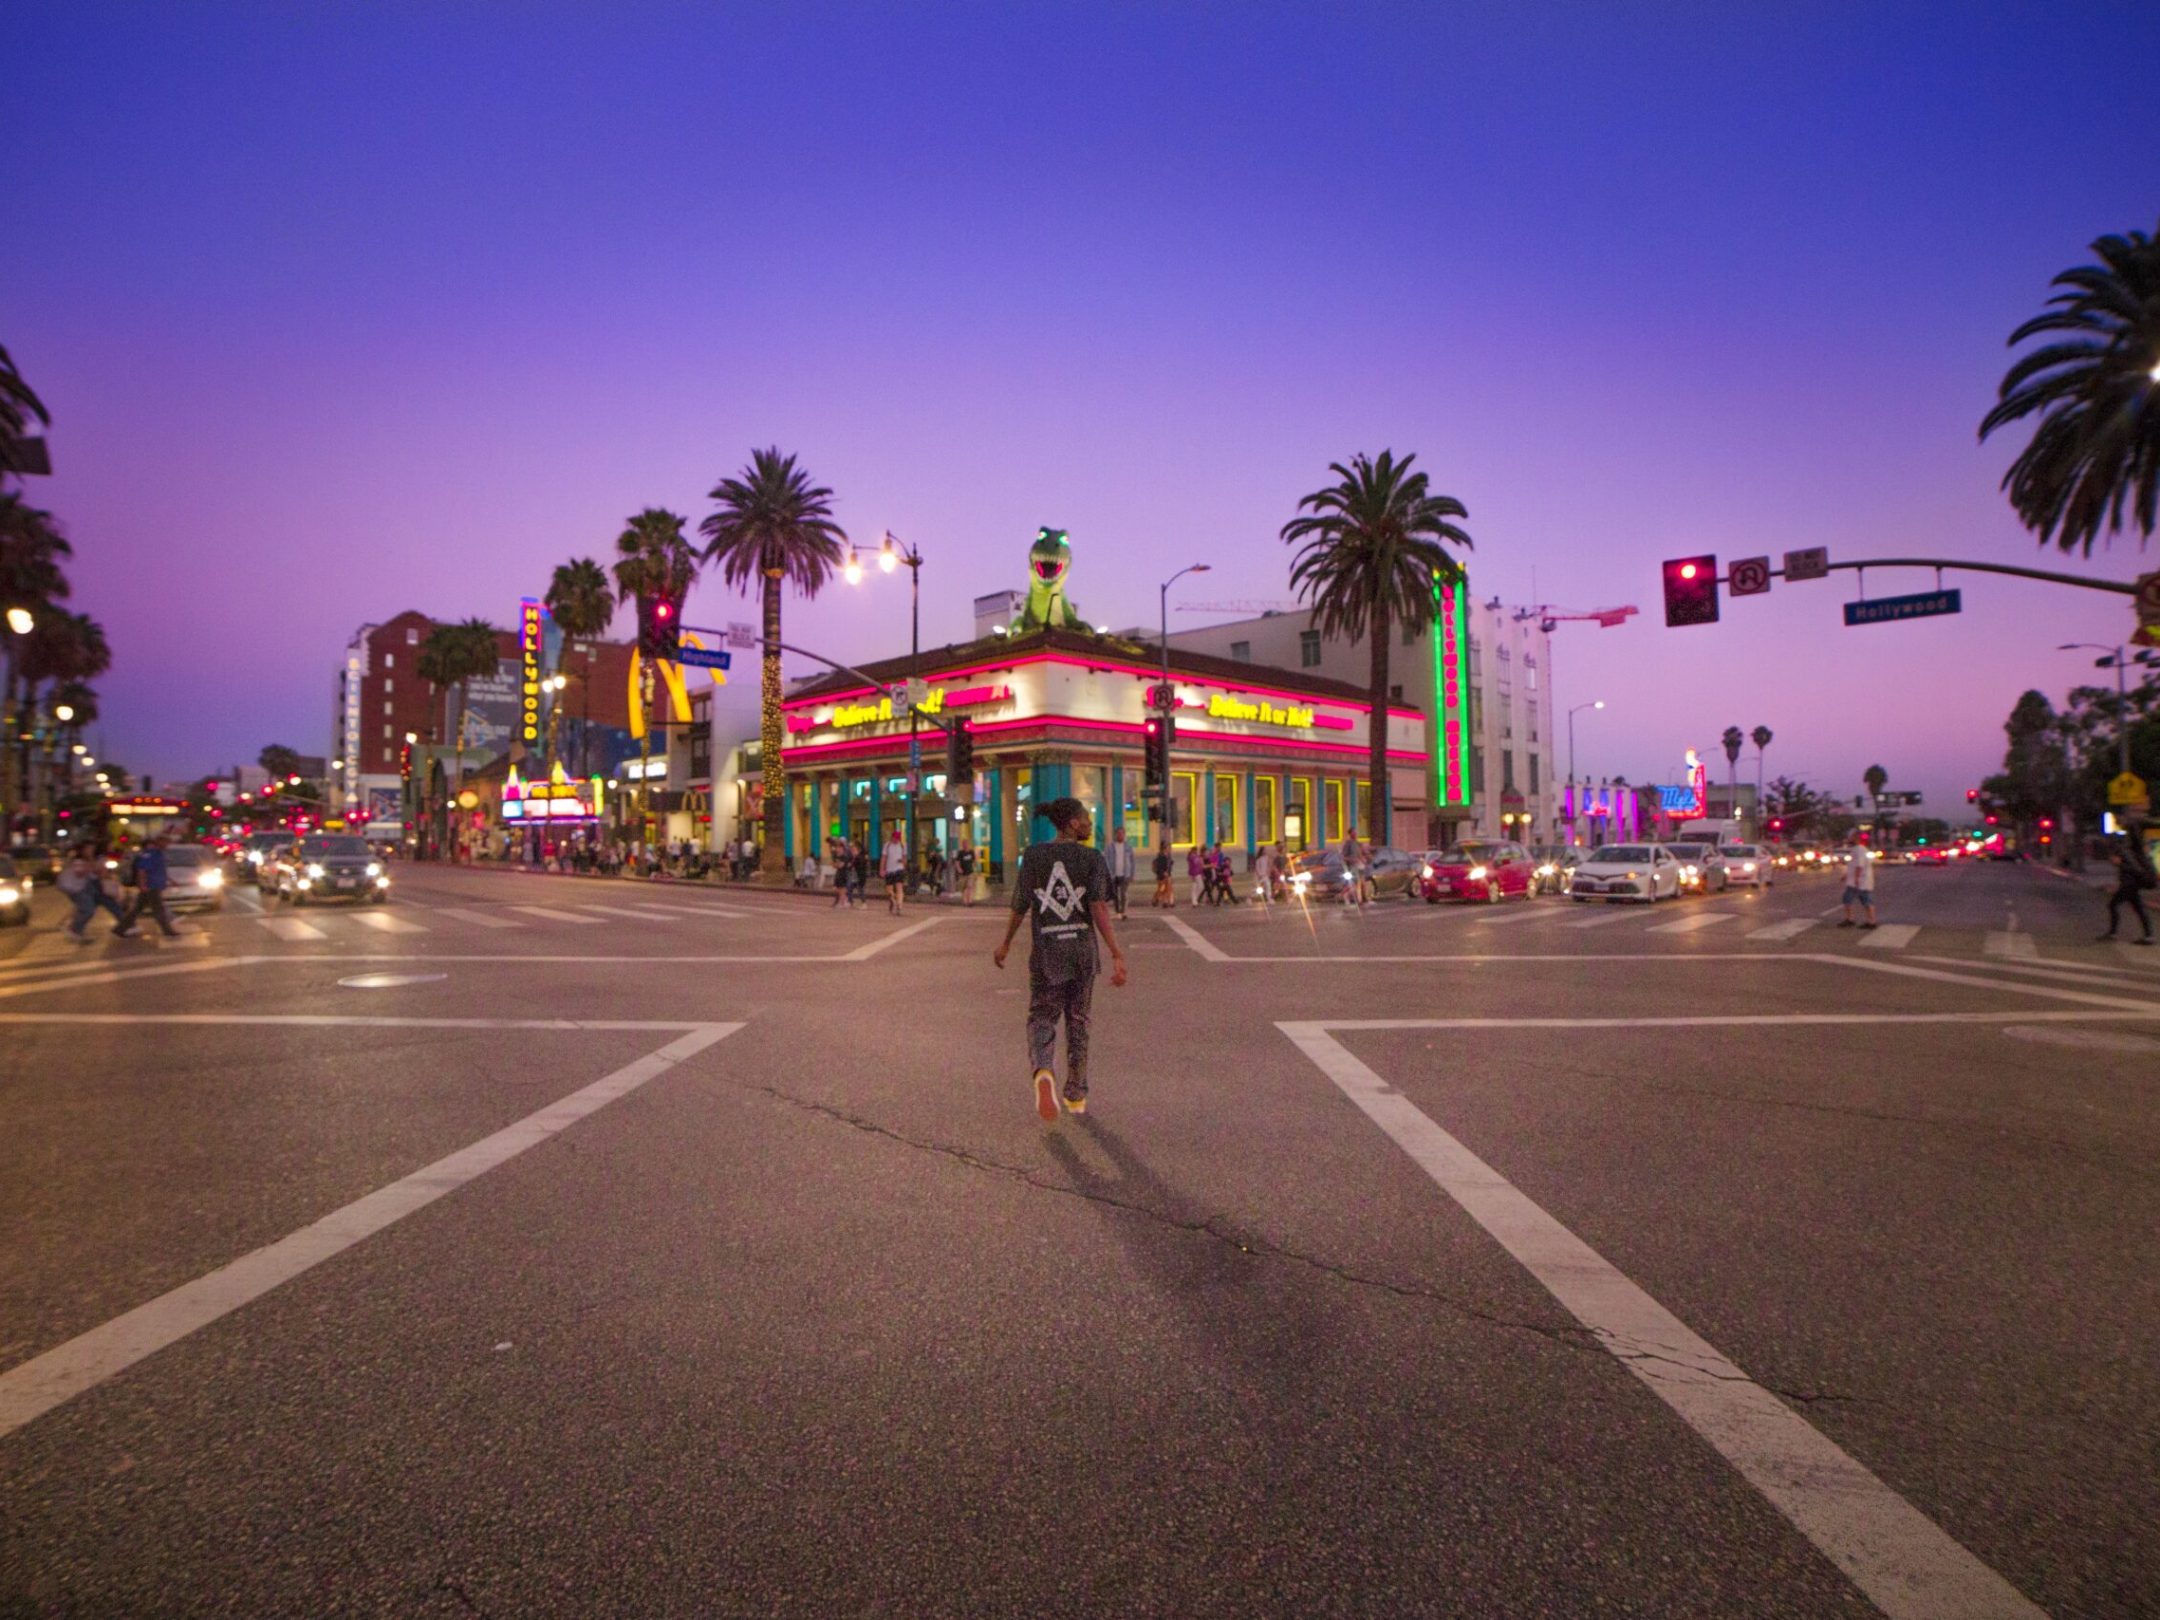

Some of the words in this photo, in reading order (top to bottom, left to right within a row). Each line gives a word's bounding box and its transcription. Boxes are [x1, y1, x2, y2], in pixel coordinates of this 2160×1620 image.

[1856, 597, 1948, 619] Hollywood
[682, 651, 726, 666] Highland
[524, 608, 538, 740] HOLLYWOOD
[832, 704, 878, 728] Believe
[1209, 694, 1258, 720] Believe
[1273, 709, 1286, 724] or
